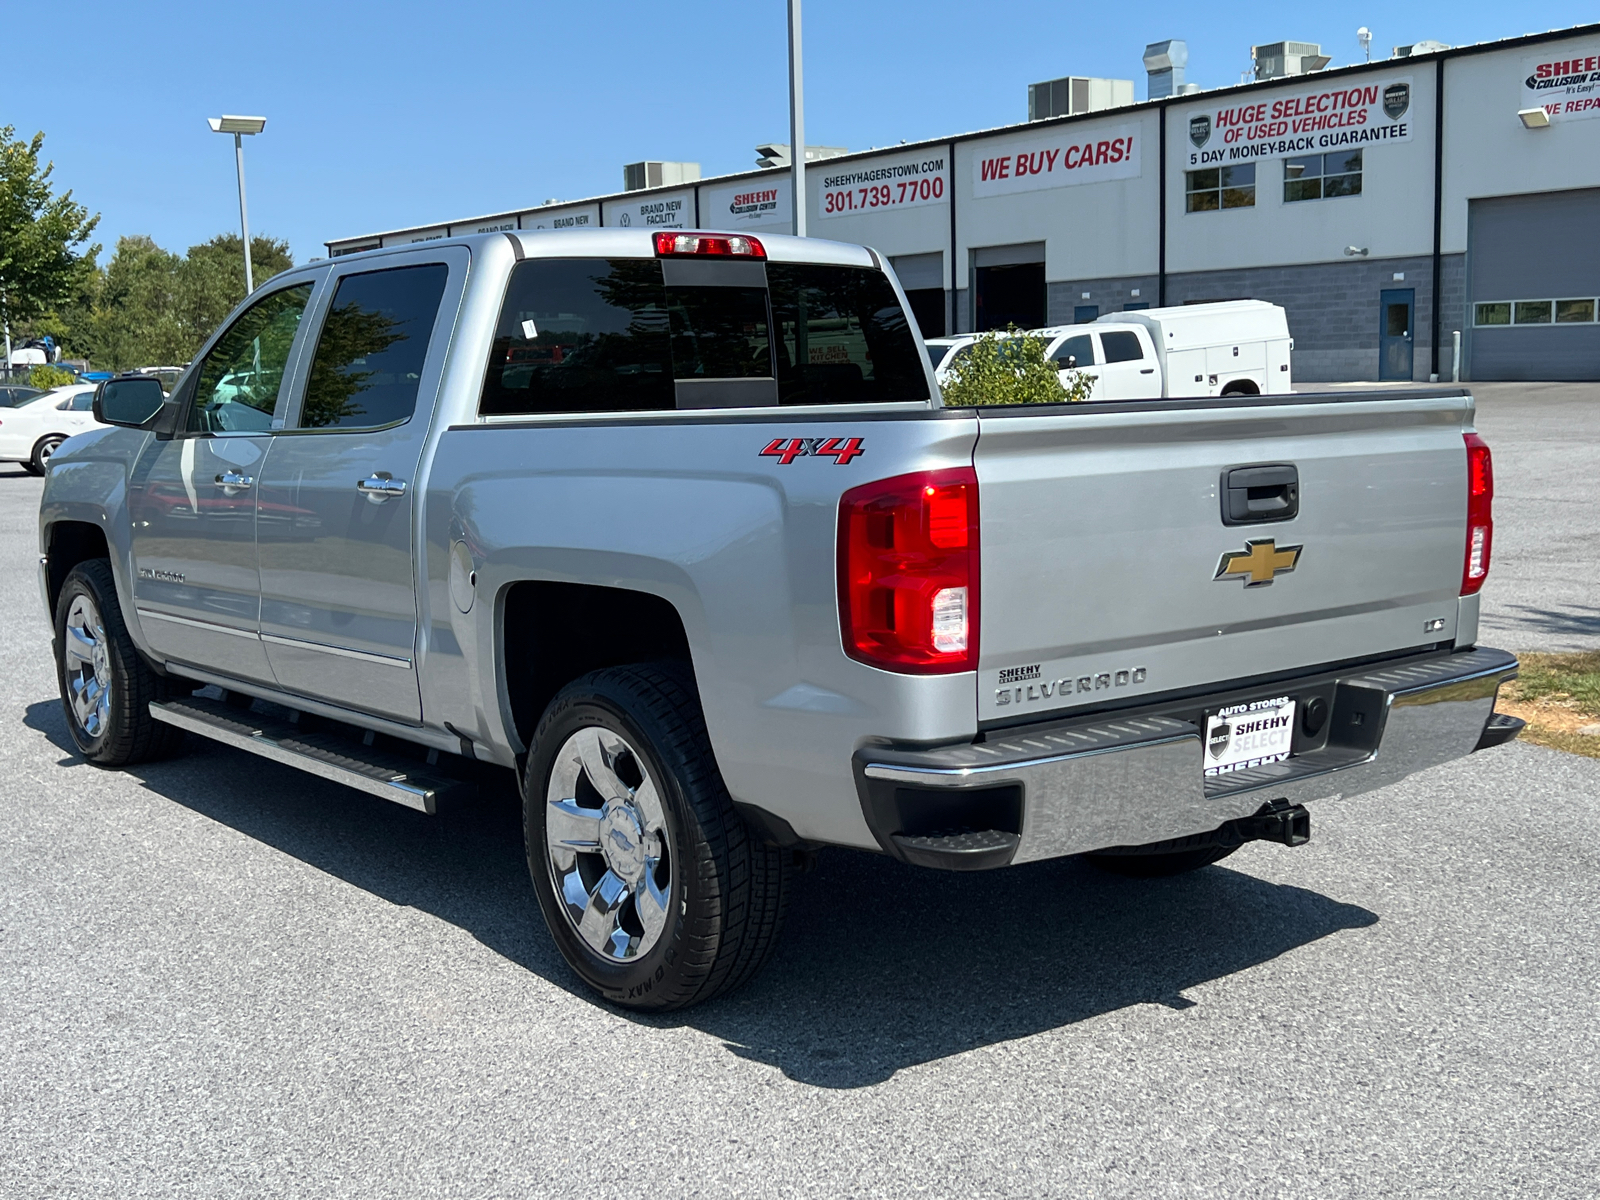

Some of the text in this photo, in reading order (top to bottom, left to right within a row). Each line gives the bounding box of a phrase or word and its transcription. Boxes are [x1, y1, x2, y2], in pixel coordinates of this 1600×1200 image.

[1536, 55, 1600, 78] SHEE
[1536, 73, 1588, 90] COLLISION
[1565, 86, 1576, 94] It's
[1215, 85, 1379, 129] HUGE SELECTION
[1224, 108, 1368, 144] OF USED VEHICLES
[1190, 123, 1408, 165] 5 DAY MONEY-BACK GUARANTEE
[981, 136, 1133, 182] WE BUY CARS!
[824, 159, 944, 188] SHEEHYHAGERSTOWN.COM
[734, 189, 778, 206] SHEEHY
[825, 176, 944, 213] 301.739.7700
[640, 200, 682, 216] BRAND NEW
[735, 201, 777, 214] COLLISION CENTER
[553, 215, 589, 229] BRAND NEW
[646, 212, 676, 226] FACILITY
[809, 345, 847, 354] WE SELL
[810, 352, 848, 361] KITCHEN
[999, 664, 1041, 679] SHEEHY
[994, 665, 1147, 706] SILVERADO
[1218, 696, 1289, 717] AUTO STORES
[1236, 715, 1290, 735] SHEEHY
[1209, 734, 1229, 745] SELECT
[1233, 728, 1289, 753] SELECT
